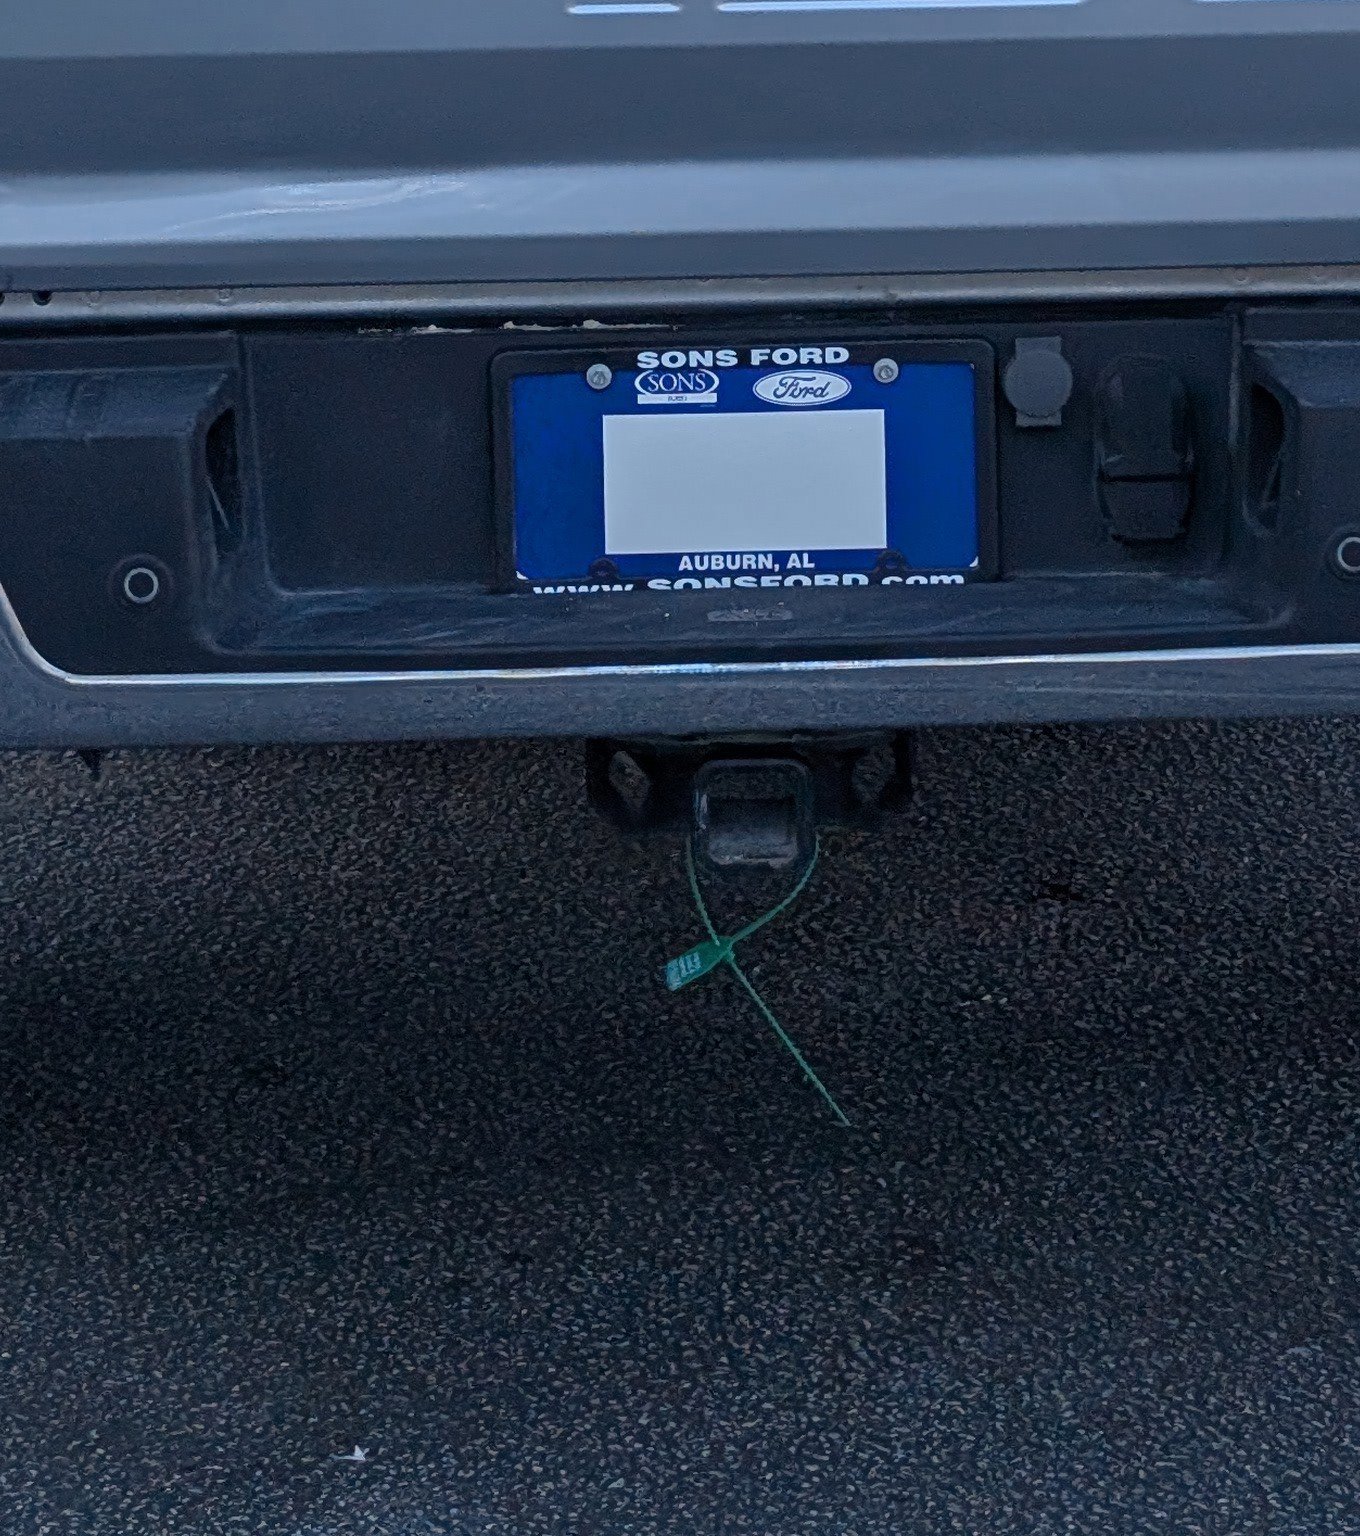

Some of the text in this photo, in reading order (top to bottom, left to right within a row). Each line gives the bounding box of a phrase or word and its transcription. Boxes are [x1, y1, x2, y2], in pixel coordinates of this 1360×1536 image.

[636, 346, 850, 369] SONS FORD
[647, 372, 707, 392] SONS
[772, 375, 831, 400] Ford
[677, 552, 816, 572] AUBURN, AL
